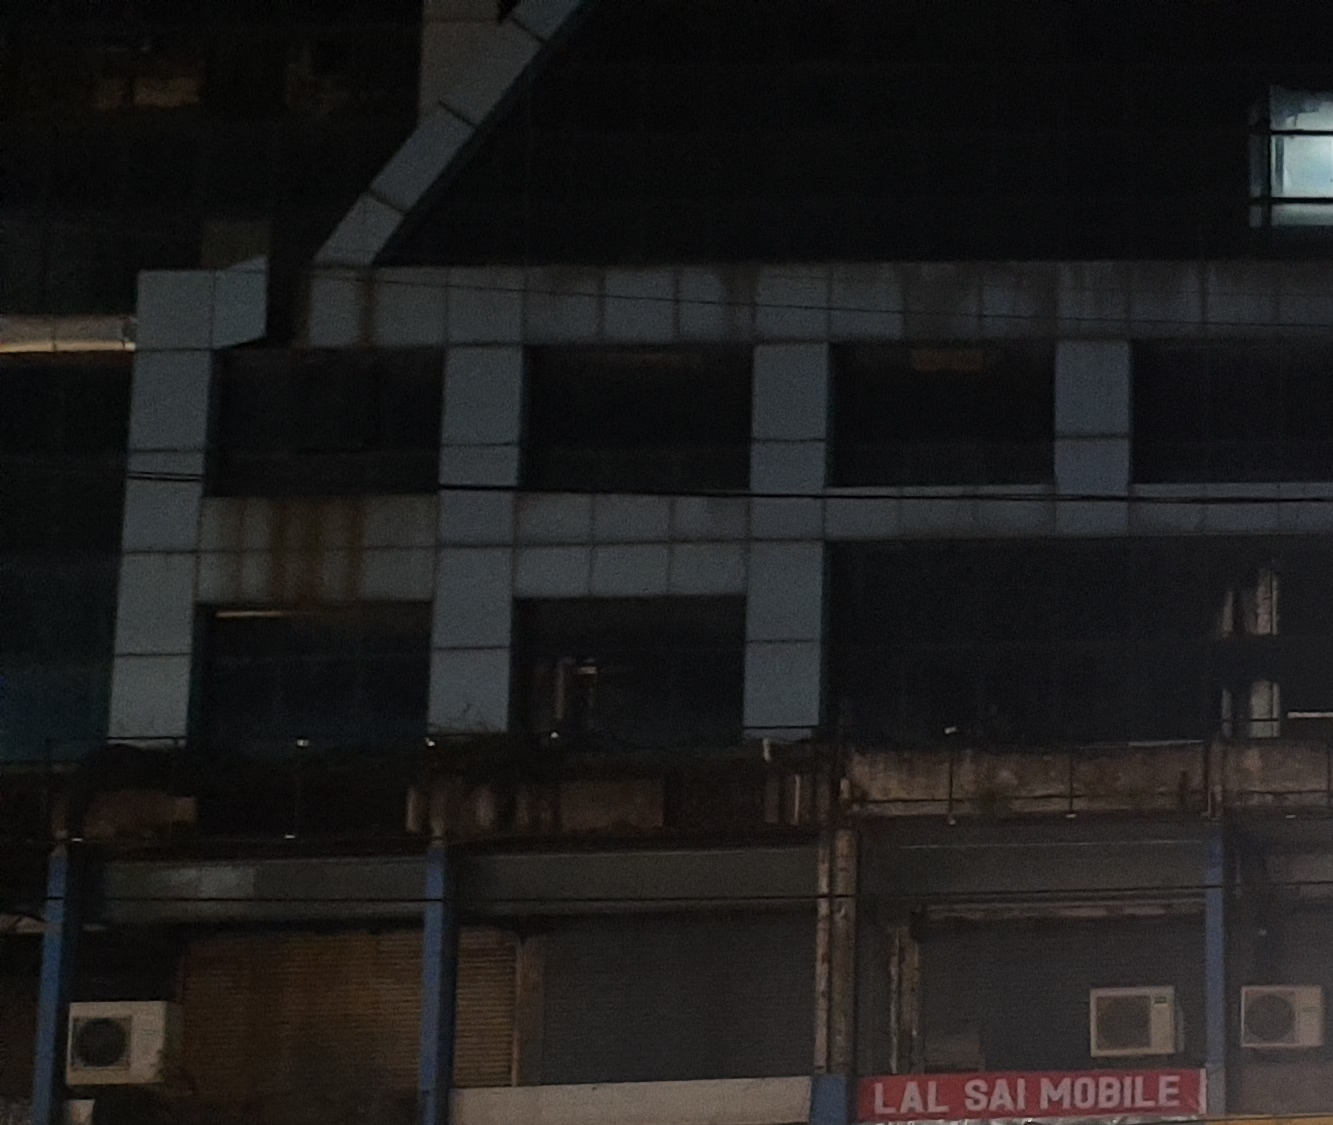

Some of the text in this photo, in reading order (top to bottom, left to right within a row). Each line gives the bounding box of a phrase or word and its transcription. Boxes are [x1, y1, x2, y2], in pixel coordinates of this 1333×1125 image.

[873, 1074, 1181, 1115] LAL SAI MOBILE
